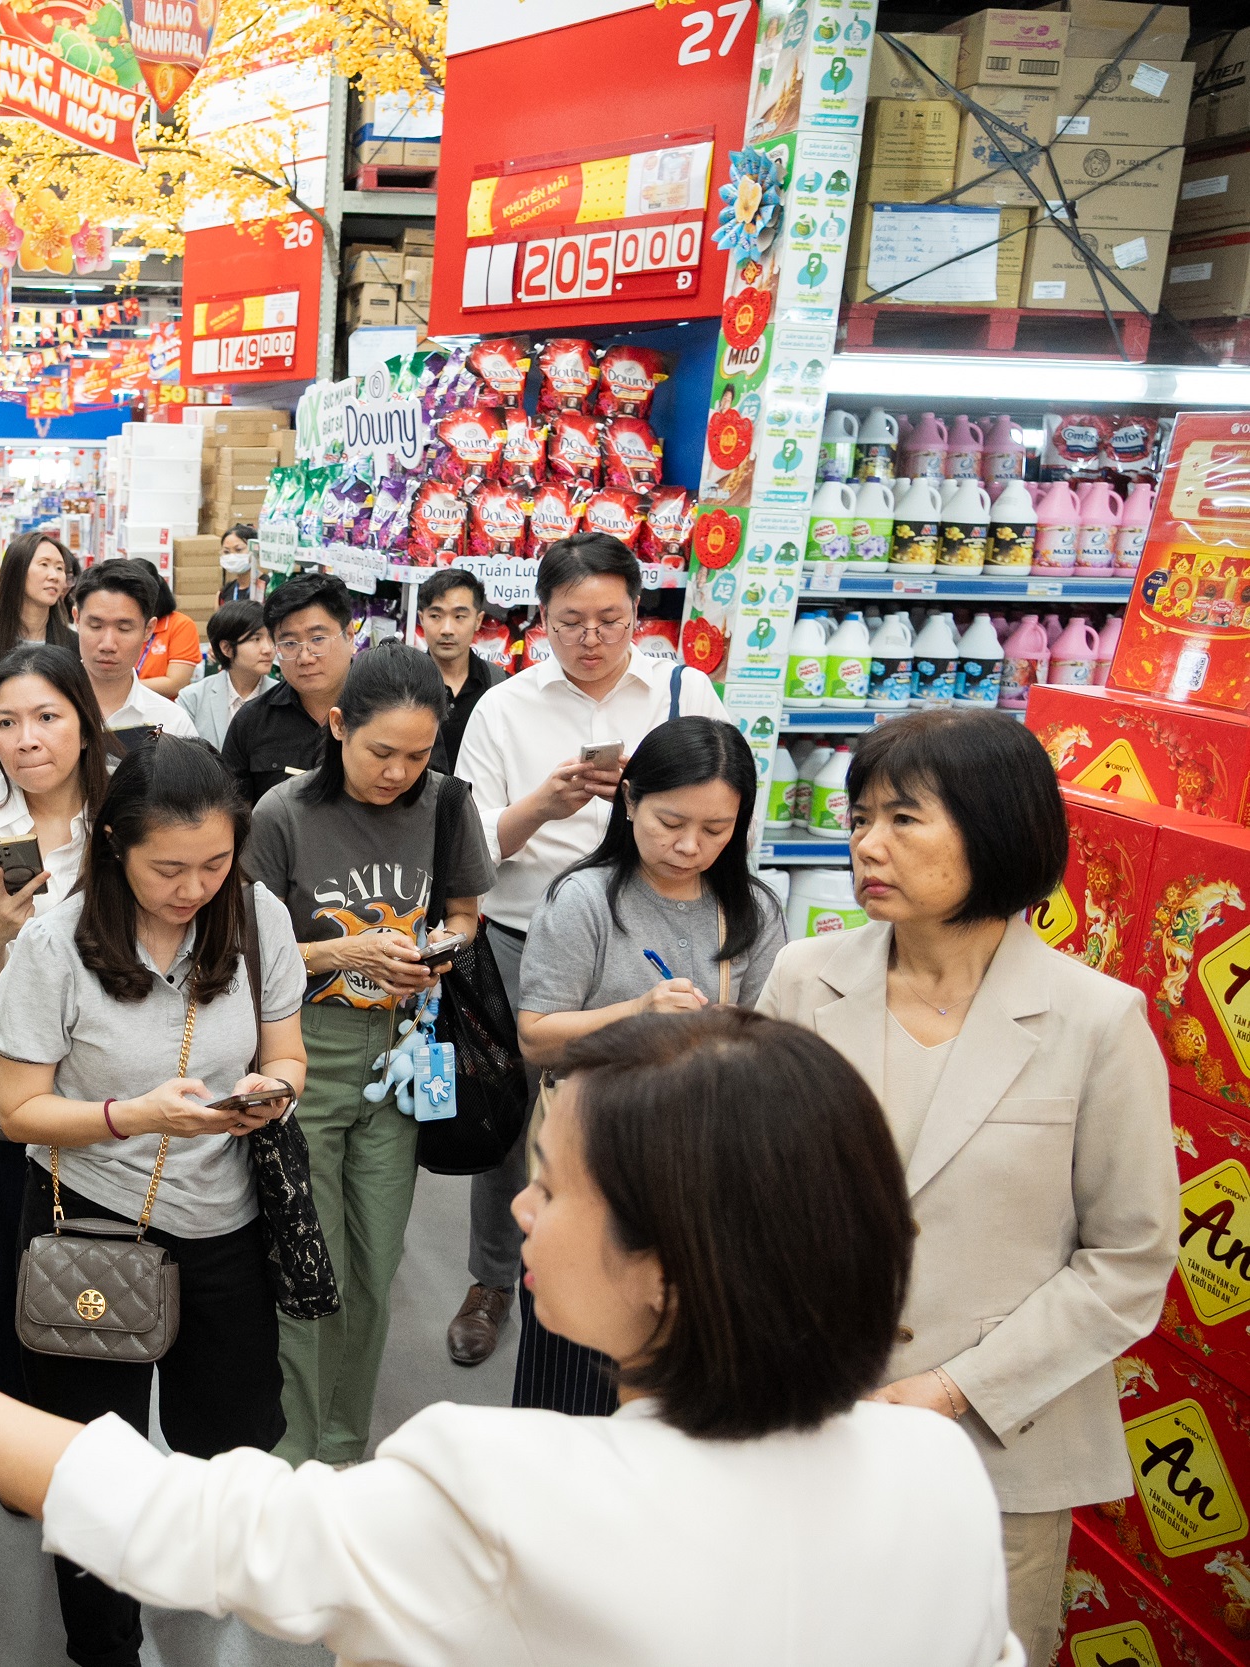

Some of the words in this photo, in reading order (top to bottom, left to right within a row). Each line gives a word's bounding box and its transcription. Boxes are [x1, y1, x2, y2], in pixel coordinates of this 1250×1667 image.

[173, 31, 205, 61] DEAL
[677, 0, 752, 66] 27
[59, 66, 137, 122] MỪNG
[65, 101, 116, 145] MỚI
[501, 186, 546, 218] KHUYẾN
[545, 174, 570, 198] MÃI
[510, 195, 562, 229] PROMOTION
[283, 218, 314, 251] 26
[726, 347, 761, 367] MILO
[158, 384, 187, 403] 50
[607, 369, 655, 391] Downy
[345, 404, 418, 459] Downy
[588, 509, 636, 530] Downy
[478, 559, 511, 578] Tuần
[640, 568, 659, 587] ng
[493, 583, 531, 602] Ngăn
[713, 583, 734, 600] A2
[798, 668, 820, 678] PRICE
[840, 667, 862, 677] PRICE
[1111, 763, 1132, 773] ORION
[313, 862, 433, 920] SATUR
[816, 922, 843, 934] PRICE
[1221, 1184, 1248, 1203] ORION
[1178, 1199, 1250, 1282] An
[1187, 1257, 1200, 1273] TÂN
[1200, 1263, 1217, 1281] NIÊN
[1216, 1273, 1230, 1290] VẠN
[1229, 1282, 1240, 1297] SỰ
[1190, 1273, 1207, 1289] KHỞI
[1207, 1281, 1221, 1299] ĐẦU
[1220, 1292, 1231, 1304] AN
[1181, 1422, 1206, 1444] ORION
[1140, 1436, 1221, 1522] An
[1149, 1487, 1162, 1502] TÂN
[1161, 1496, 1177, 1515] NIÊN
[1176, 1508, 1189, 1526] VẠN
[1188, 1518, 1199, 1534] SỰ
[1151, 1502, 1168, 1522] KHỞI
[1180, 1526, 1191, 1539] AN
[1129, 1643, 1151, 1666] ORION
